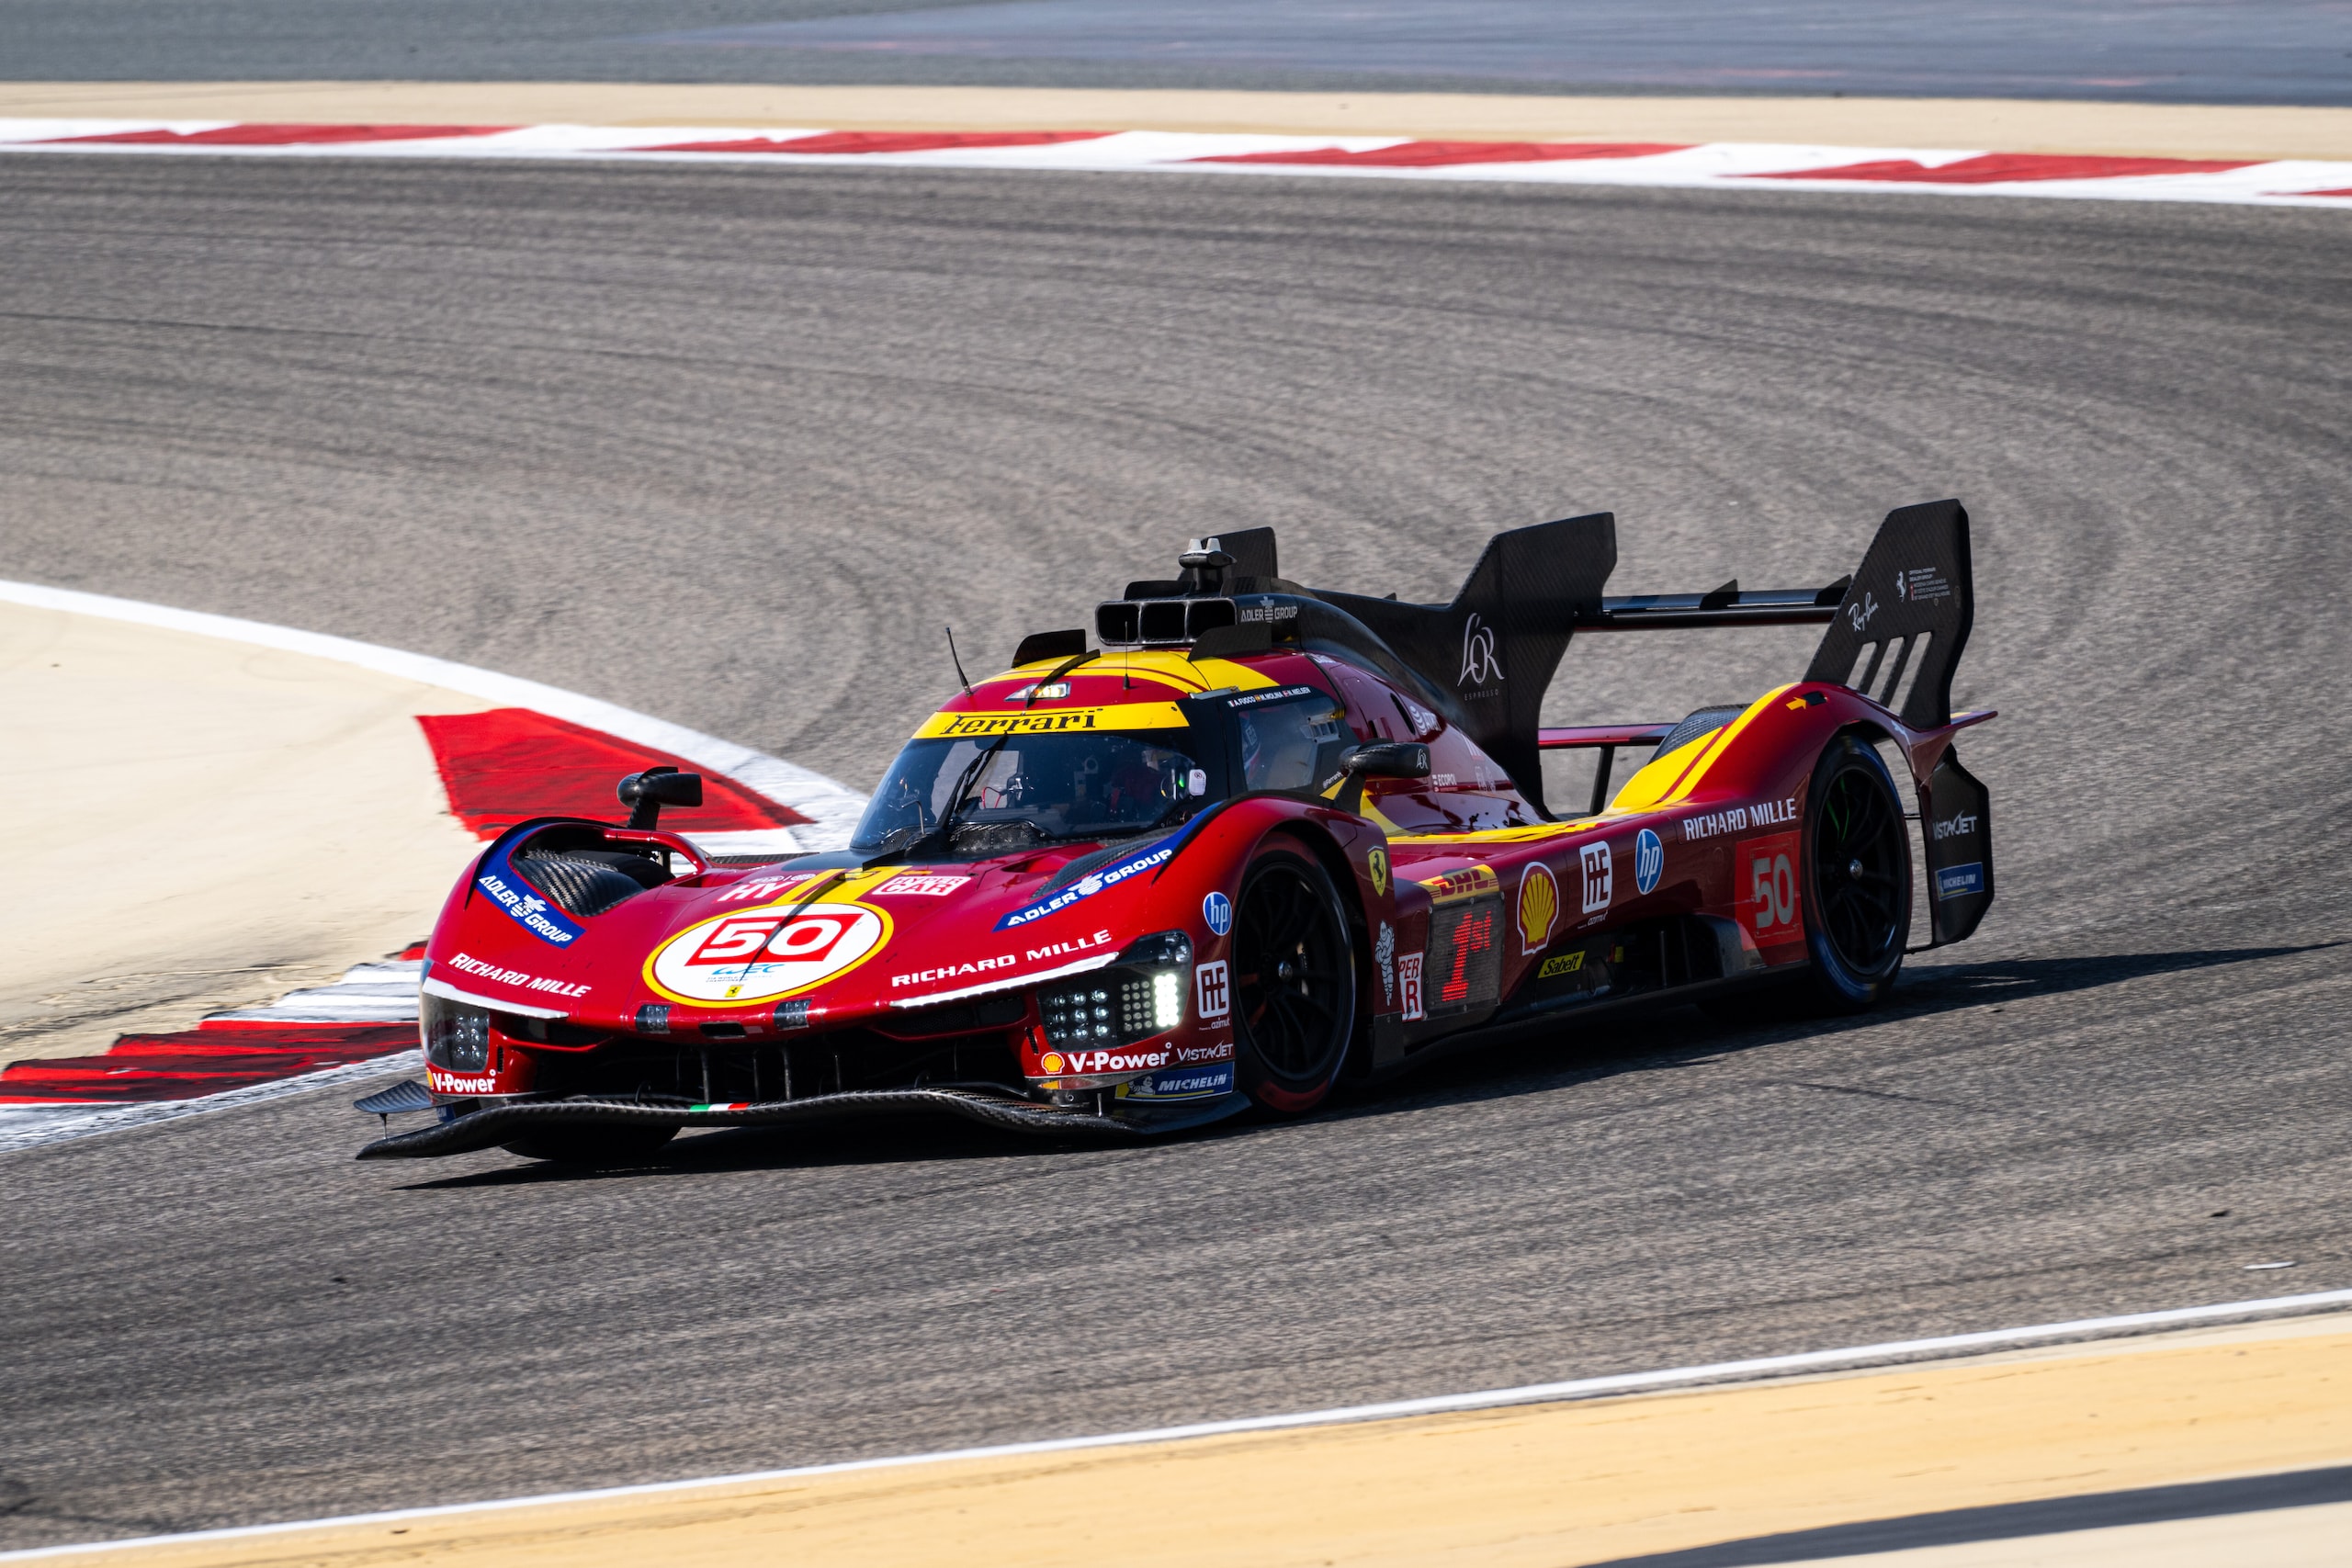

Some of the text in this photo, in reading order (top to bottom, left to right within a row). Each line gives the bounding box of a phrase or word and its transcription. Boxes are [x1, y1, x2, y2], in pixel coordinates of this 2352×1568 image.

[1240, 606, 1298, 623] ADLER GROUP
[1848, 592, 1879, 632] Ray-Ban
[1464, 688, 1499, 701] ESPRESSO
[940, 709, 1096, 735] Ferrari
[1682, 797, 1797, 841] RICHARD MILLE
[1638, 829, 1660, 894] hp
[717, 881, 797, 903] HY
[879, 883, 952, 894] CAR
[1007, 849, 1172, 927] ADLER GROUP
[1431, 869, 1489, 897] DHL
[1752, 852, 1794, 929] 50
[478, 875, 573, 942] ADLER GROUP
[1209, 894, 1228, 935] hp
[698, 919, 842, 959] 50
[711, 964, 786, 976] WEC
[891, 930, 1113, 987] RICHARD MILLE
[1544, 954, 1580, 976] Sabelt
[447, 952, 592, 998] RICHARD MILLE
[1211, 1016, 1230, 1030] azimut
[1068, 1052, 1170, 1073] V-Power
[433, 1072, 496, 1093] V-Power
[1158, 1073, 1227, 1091] MICHELIN
